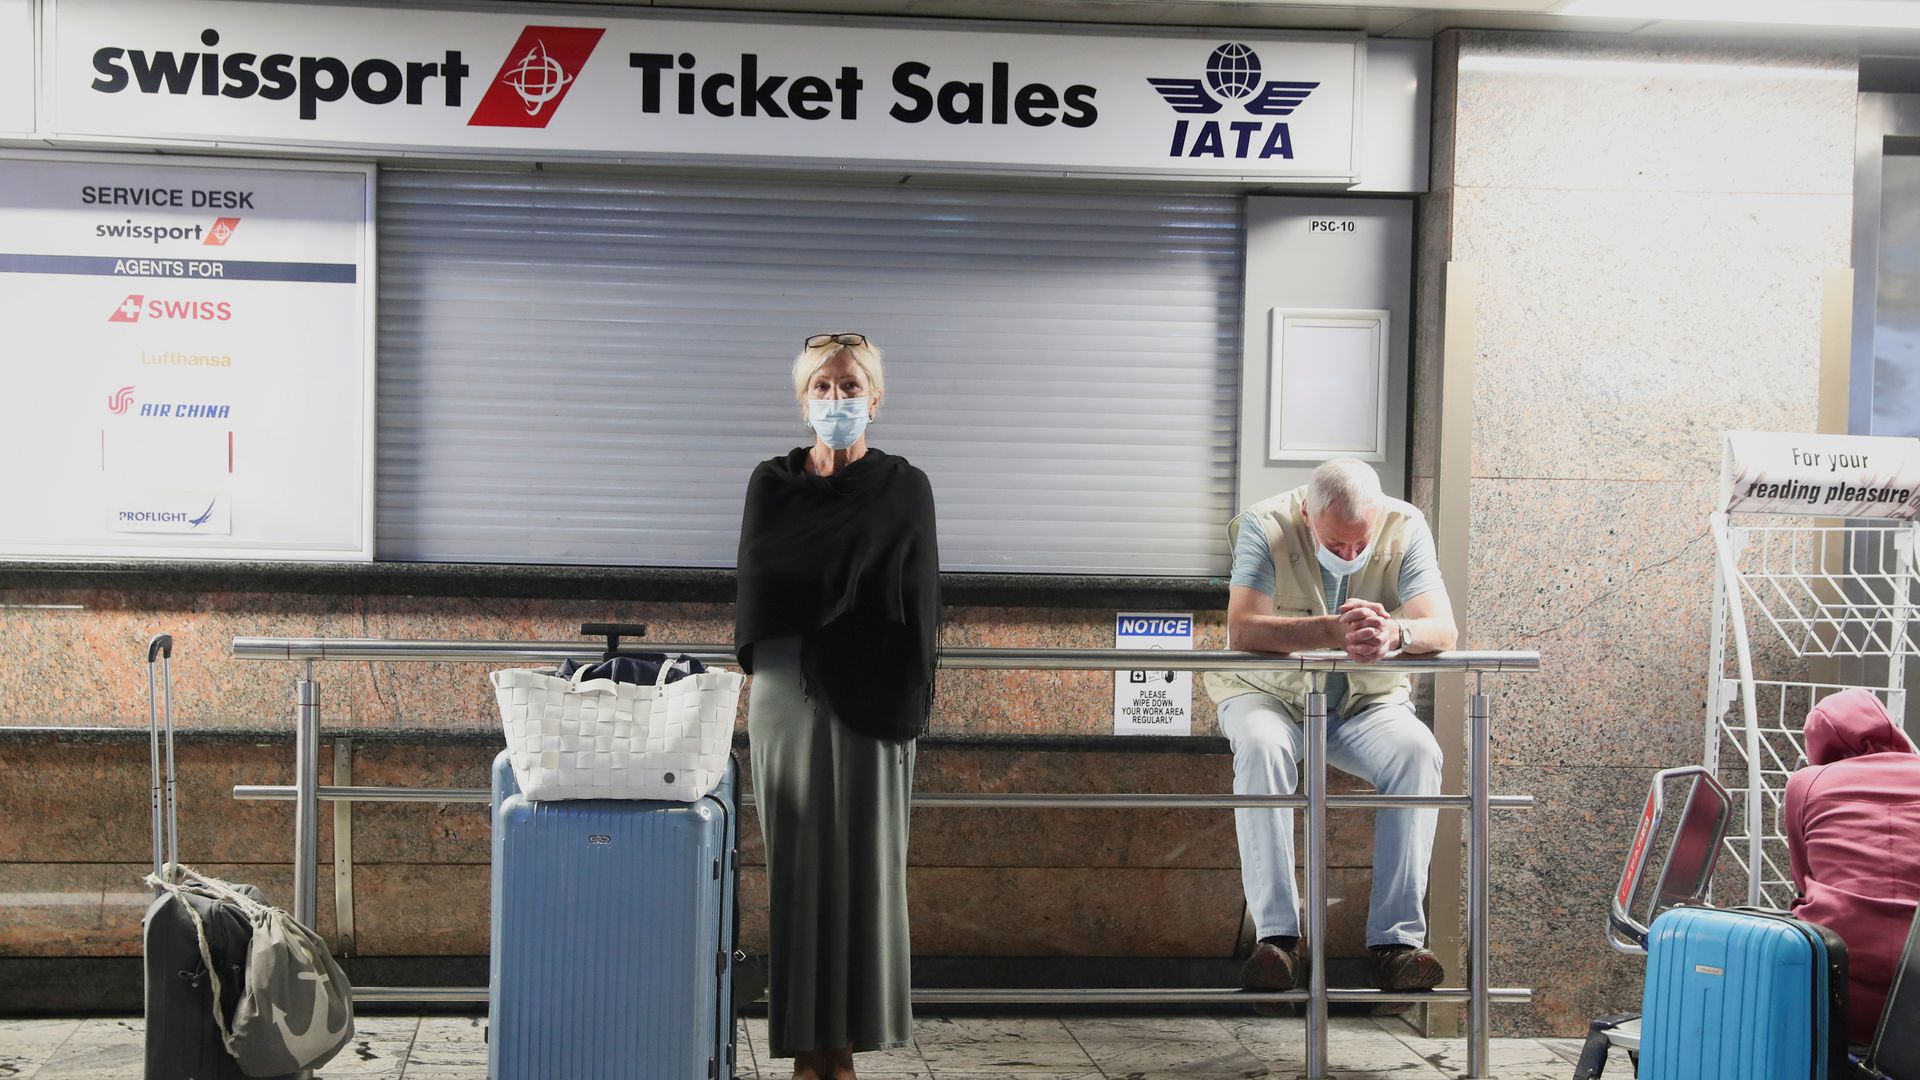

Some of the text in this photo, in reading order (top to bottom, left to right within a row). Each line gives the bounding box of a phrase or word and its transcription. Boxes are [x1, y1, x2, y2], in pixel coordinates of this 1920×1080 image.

[91, 29, 1098, 128] swissport Ticket Sales
[1170, 120, 1294, 160] IATA
[82, 186, 254, 209] SERVICE DESK
[95, 219, 202, 243] swissport
[1312, 220, 1355, 231] PSC-10
[114, 260, 224, 277] AGENTS FOR
[148, 300, 232, 321] SWISS
[141, 351, 232, 367] Lufthansa
[140, 403, 230, 418] AIR CHINA
[1792, 448, 1868, 472] For your
[1748, 479, 1910, 504] reading pleasure
[119, 511, 188, 523] PROFLIGHT
[1121, 619, 1188, 634] NOTICE
[1133, 698, 1173, 707] WIPE DOWN
[1140, 690, 1167, 699] PLEASE
[1122, 707, 1184, 716] YOUR WORK AREA
[1132, 716, 1173, 724] REGULARLY
